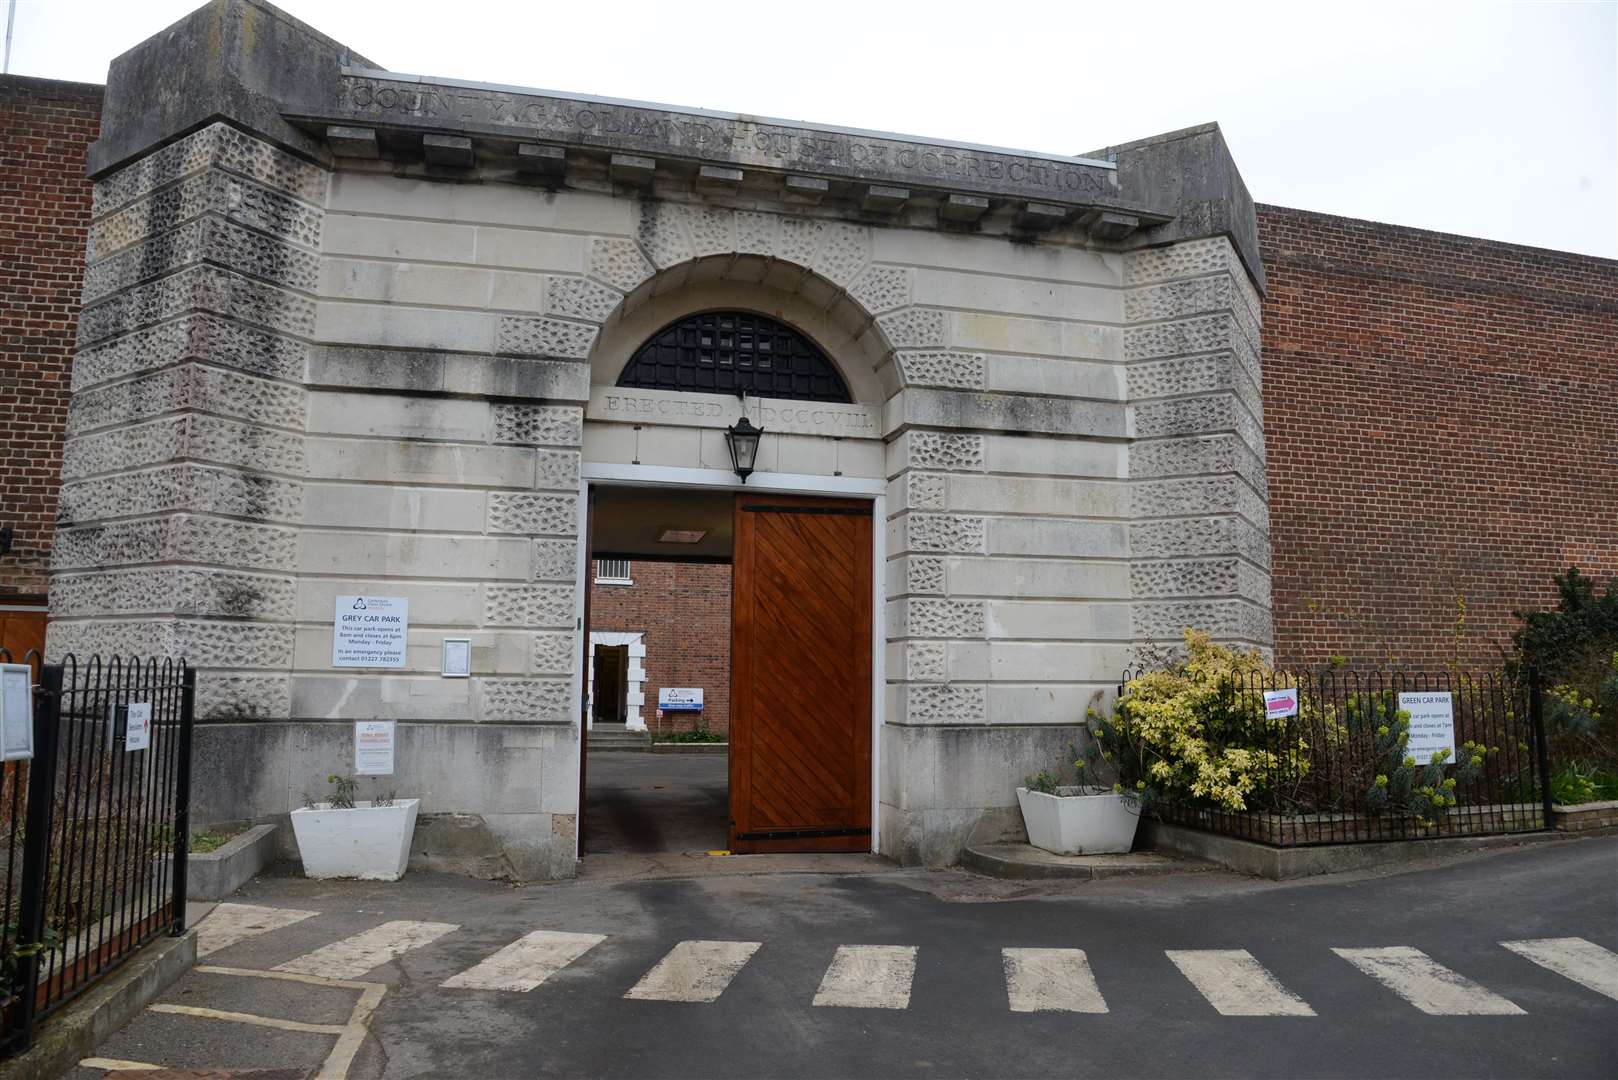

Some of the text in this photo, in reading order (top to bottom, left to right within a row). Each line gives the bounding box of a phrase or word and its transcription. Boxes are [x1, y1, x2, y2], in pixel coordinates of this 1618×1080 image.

[728, 127, 839, 160] HOUSE
[899, 149, 1110, 193] CORRECTION
[342, 614, 362, 622] GREY
